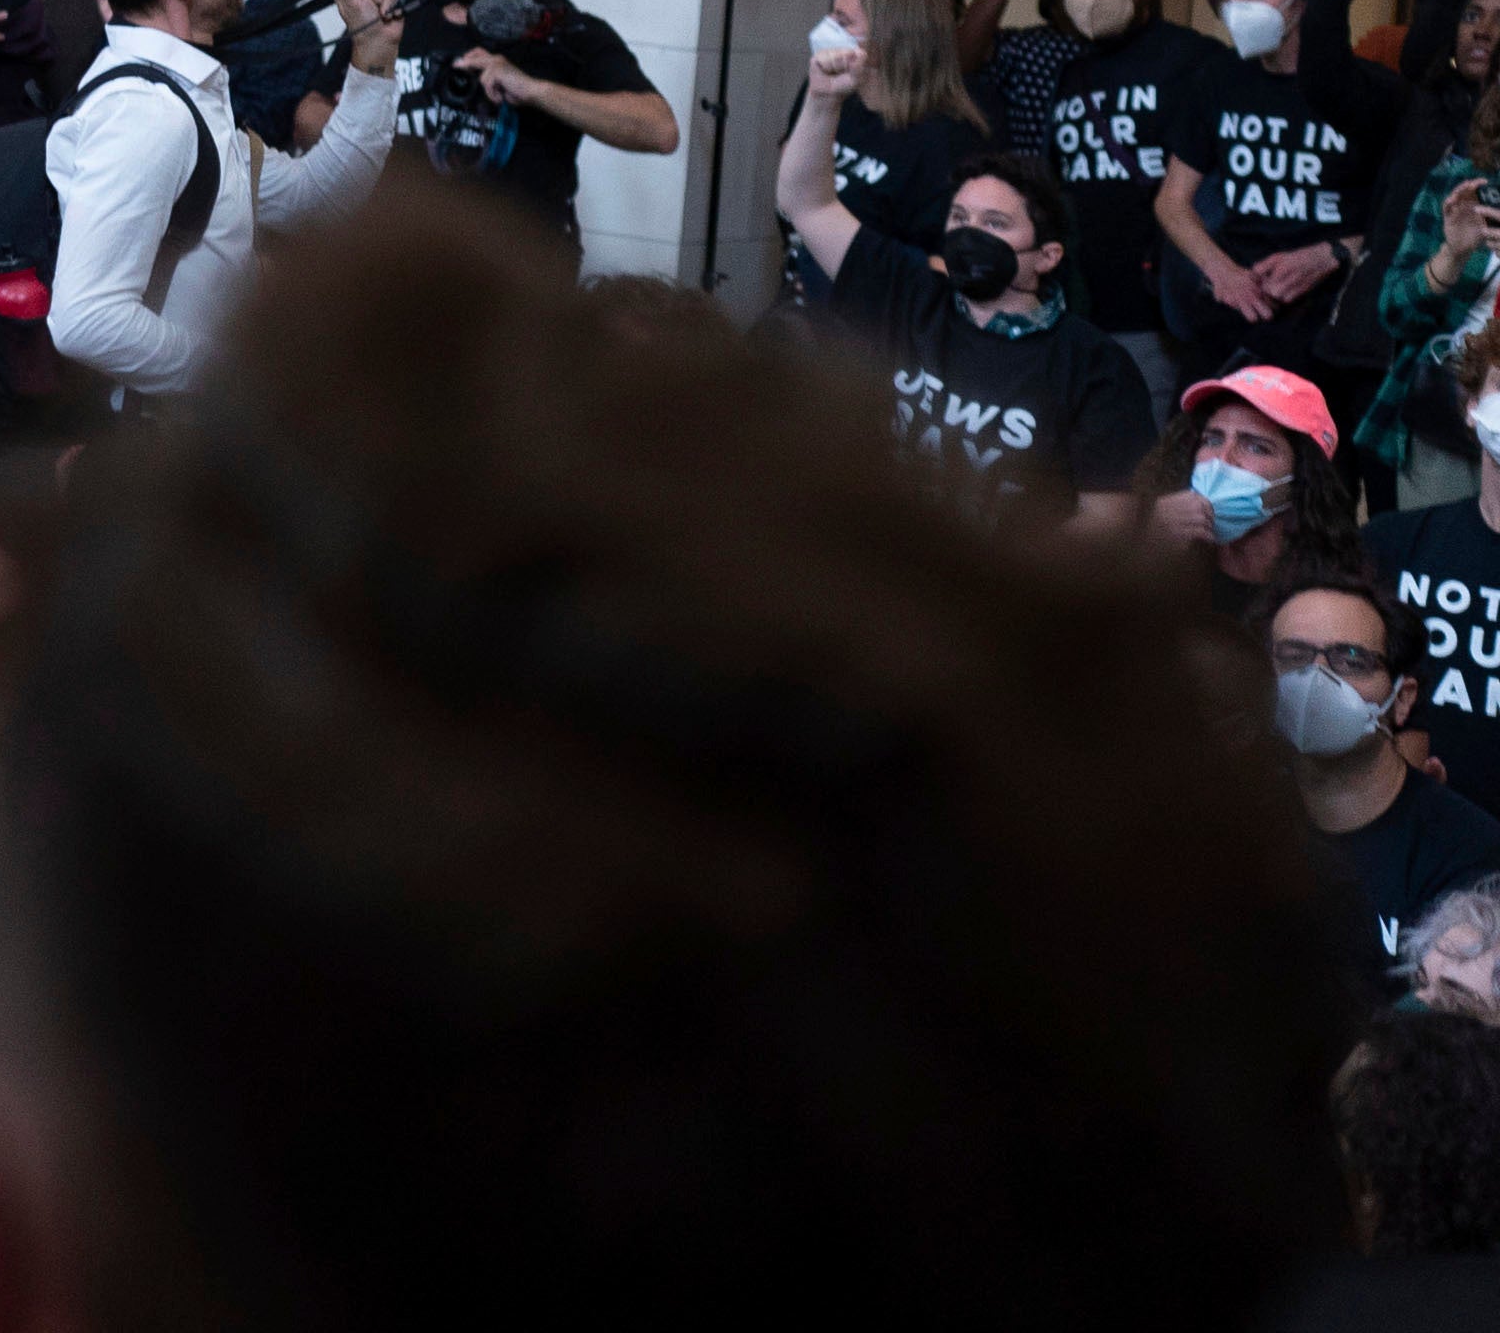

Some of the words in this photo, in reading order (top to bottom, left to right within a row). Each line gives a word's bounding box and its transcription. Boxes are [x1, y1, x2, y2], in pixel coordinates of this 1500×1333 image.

[1116, 84, 1158, 112] IN
[1218, 110, 1289, 145] NOT
[1303, 120, 1348, 154] IN
[1060, 146, 1167, 183] AME
[1228, 142, 1323, 187] OUR
[893, 366, 1037, 451] JEWS
[1422, 616, 1500, 669] OU
